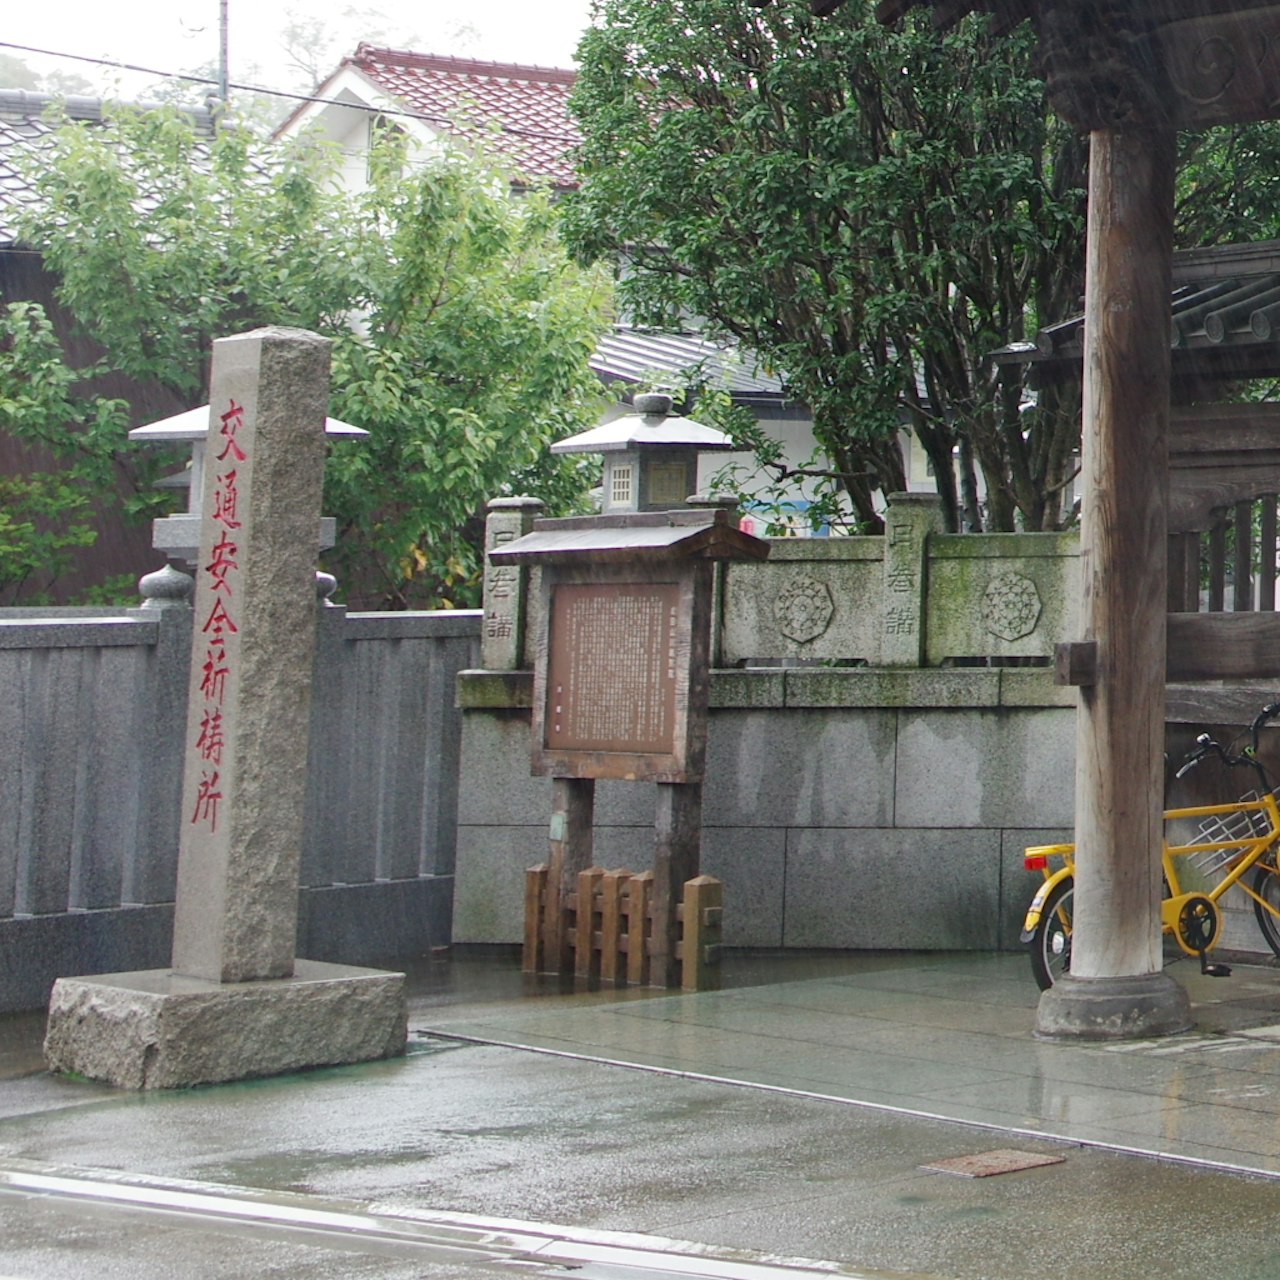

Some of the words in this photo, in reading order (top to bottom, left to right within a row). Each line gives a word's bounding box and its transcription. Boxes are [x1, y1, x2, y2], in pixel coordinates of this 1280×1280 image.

[190, 399, 248, 834] 交通安全祈祷所
